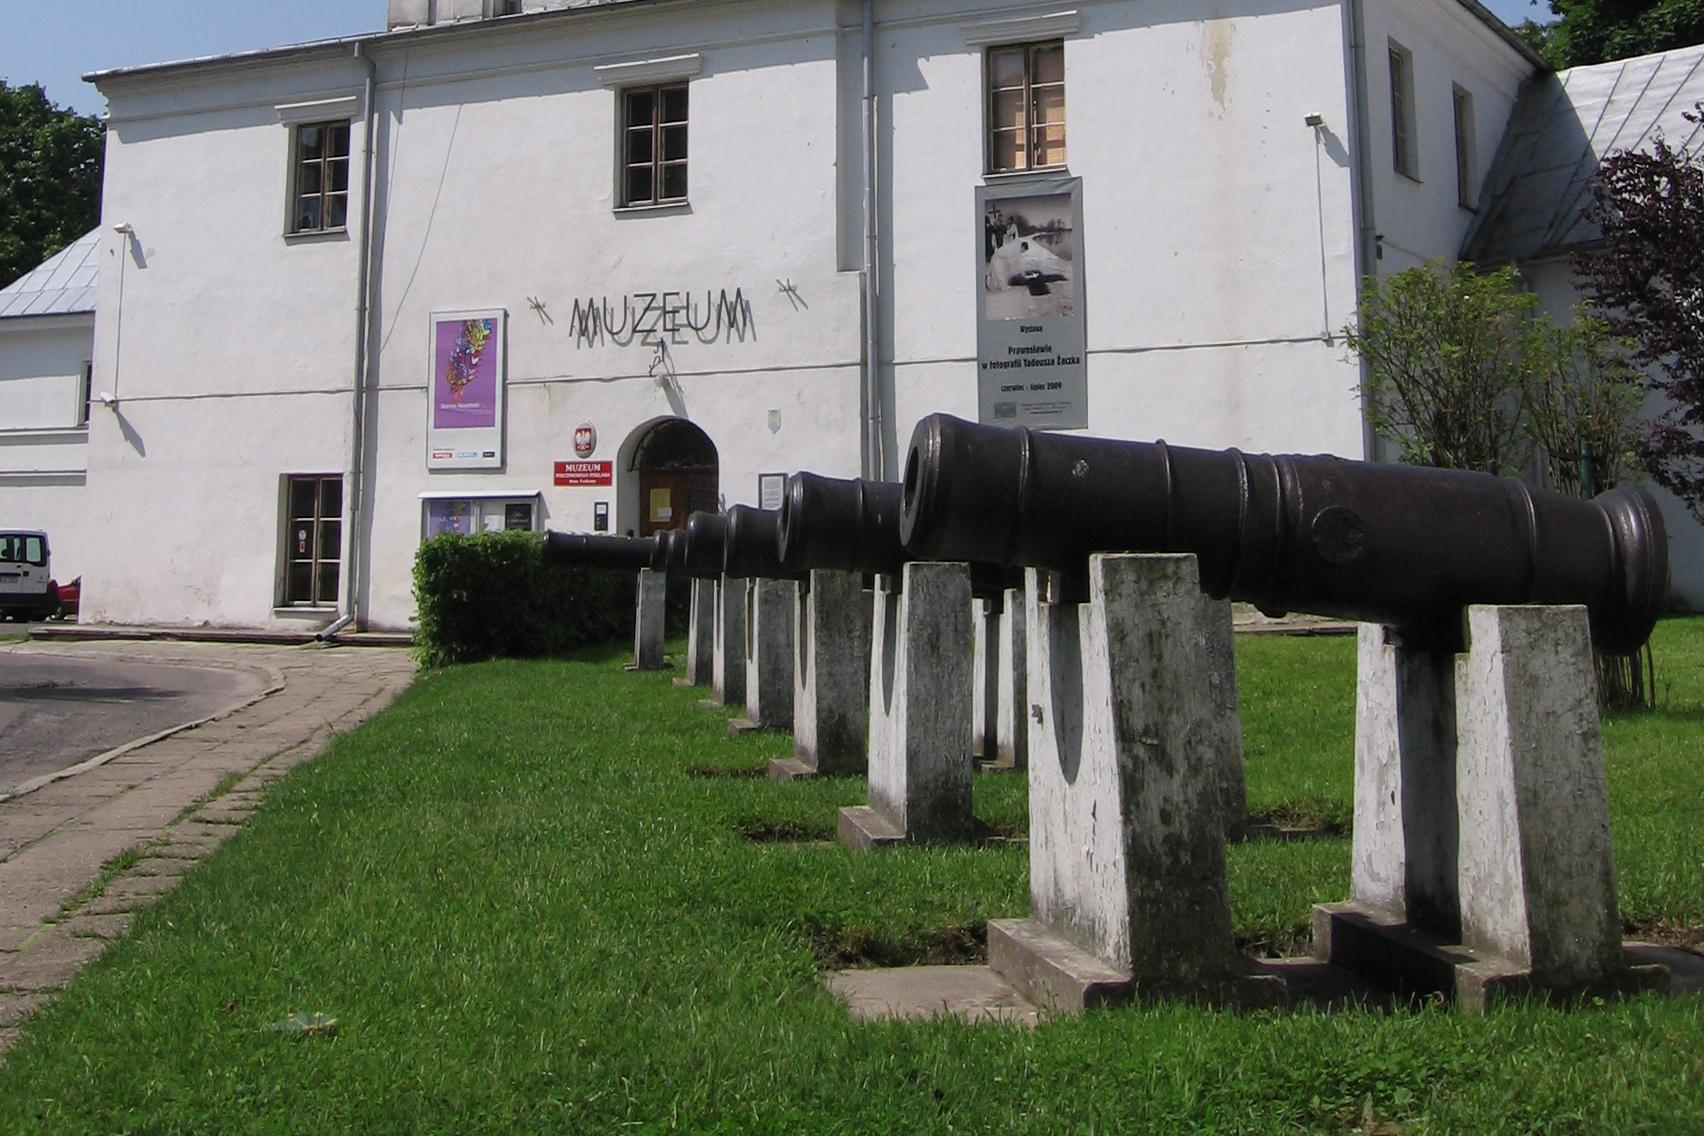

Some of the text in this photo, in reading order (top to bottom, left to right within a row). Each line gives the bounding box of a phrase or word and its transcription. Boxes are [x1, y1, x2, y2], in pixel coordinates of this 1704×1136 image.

[568, 286, 748, 338] MUZEUM
[989, 359, 1022, 370] fotografii
[1023, 357, 1055, 367] Tadeusza
[1047, 381, 1062, 390] 2009
[565, 463, 601, 472] MUZEUM
